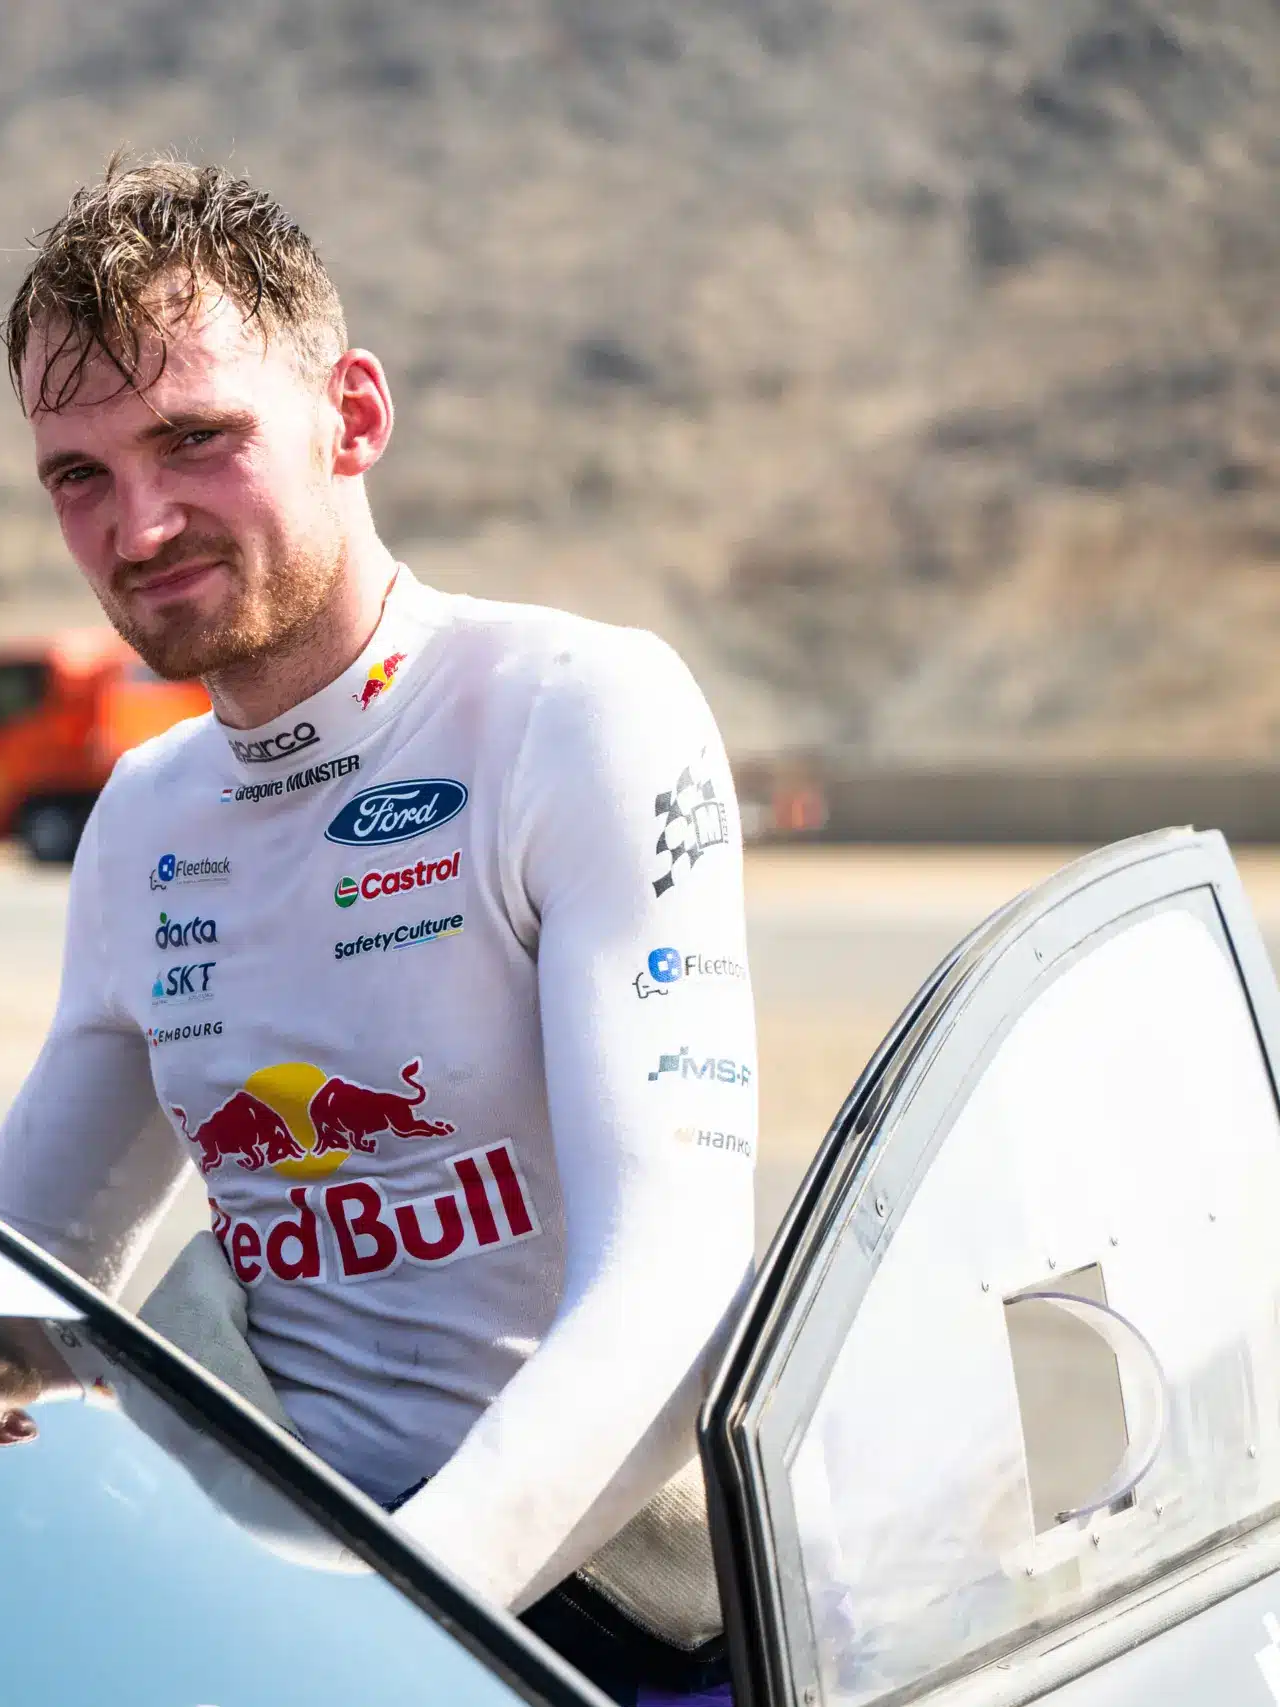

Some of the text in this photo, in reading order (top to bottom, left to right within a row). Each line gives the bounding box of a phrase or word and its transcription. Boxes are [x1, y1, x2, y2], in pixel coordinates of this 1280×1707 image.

[286, 754, 361, 792] MUNSTER
[353, 789, 438, 837] Ford
[176, 857, 230, 877] Fleetback
[361, 852, 461, 899] Castrol
[155, 912, 218, 949] darta
[335, 914, 463, 959] SafetyCulture
[166, 962, 217, 996] SKT
[325, 1146, 534, 1277] Bull
